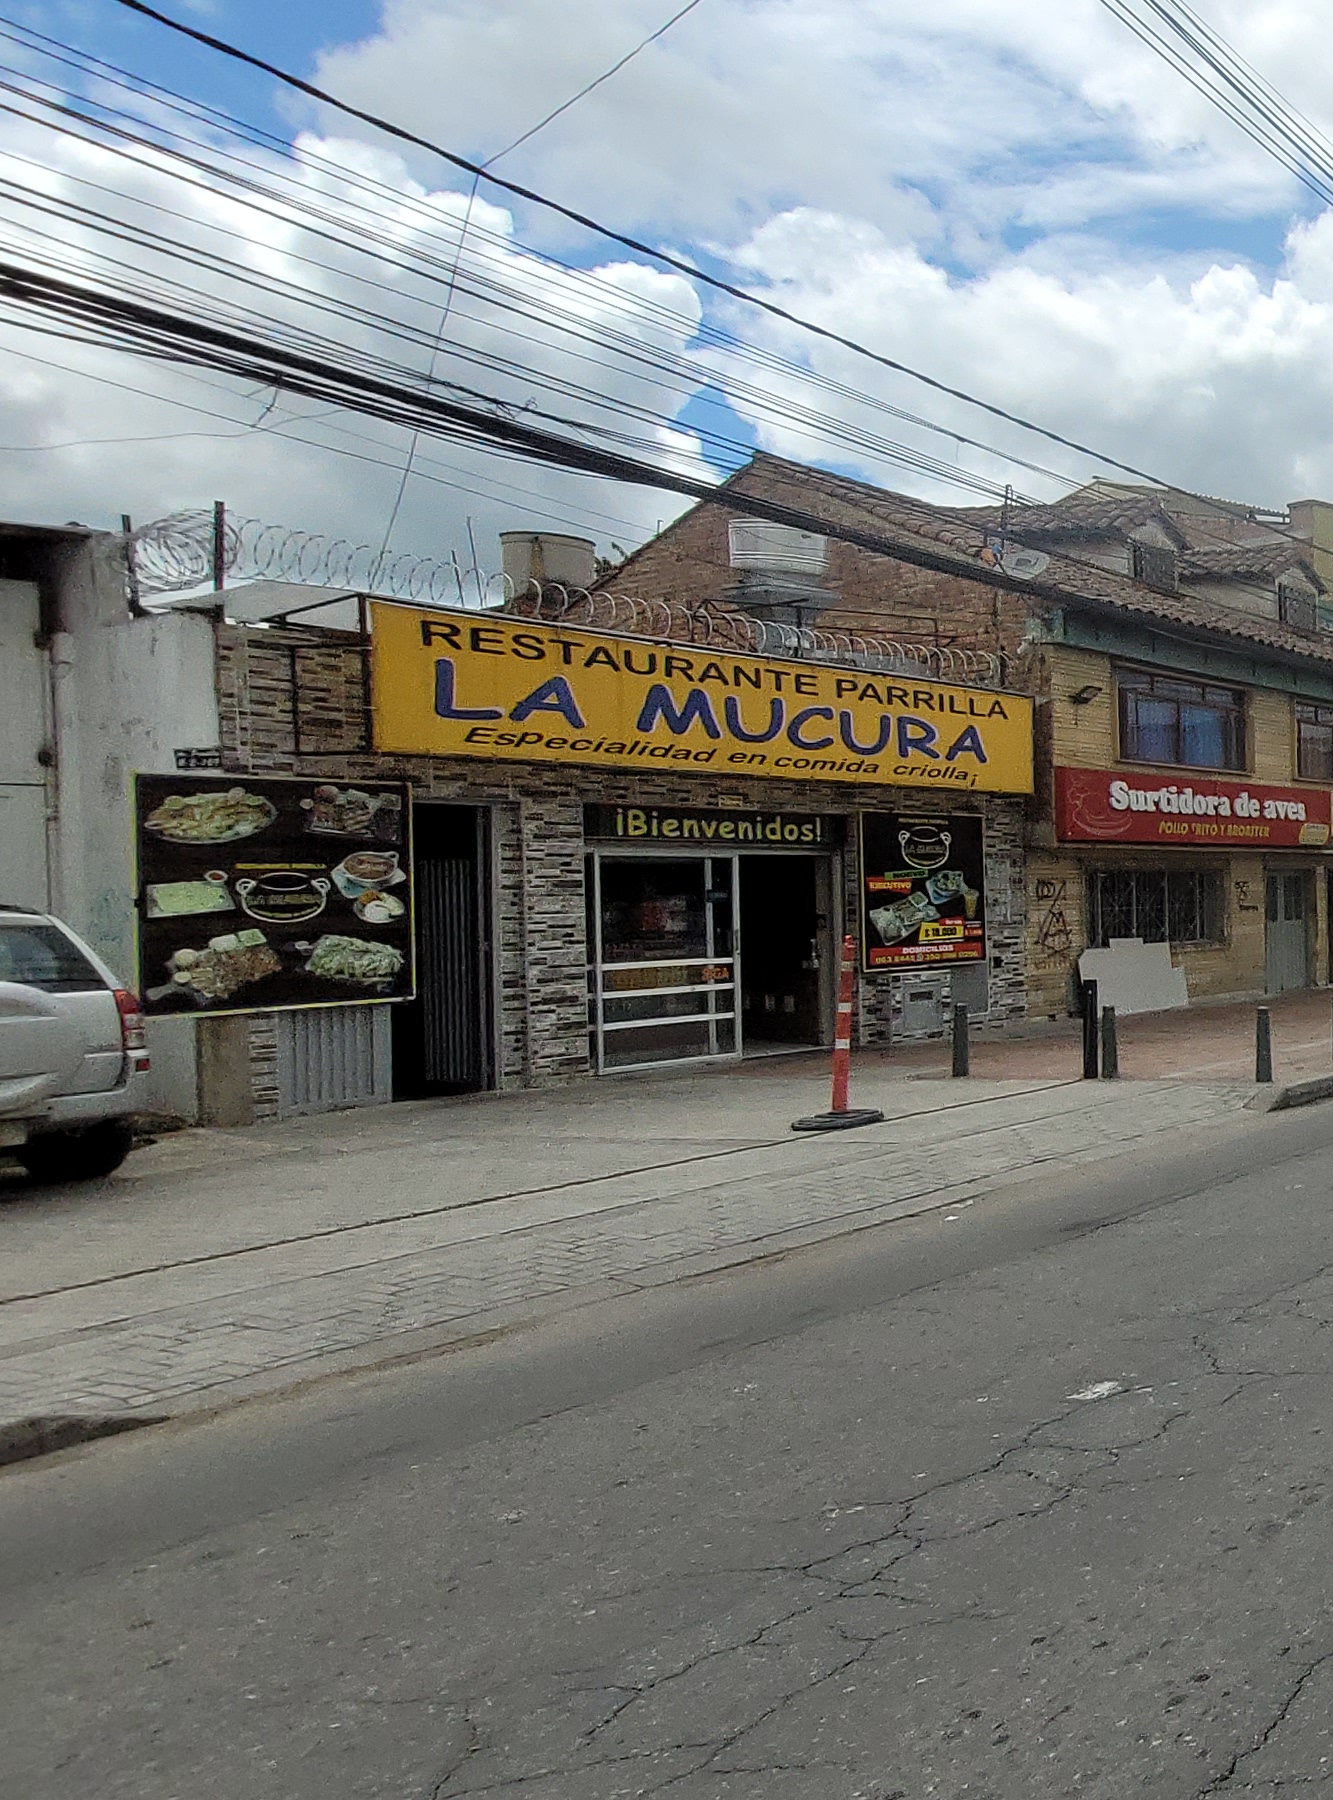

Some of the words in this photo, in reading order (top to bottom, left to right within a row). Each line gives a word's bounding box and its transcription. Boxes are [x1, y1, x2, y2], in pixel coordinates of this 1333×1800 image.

[420, 618, 819, 696] RESTAURANTE
[834, 677, 1009, 720] PARRILLA
[434, 657, 586, 729] LA
[635, 682, 988, 764] MUCURA
[463, 726, 731, 765] Especialidad
[731, 750, 769, 766] en
[773, 752, 880, 777] comida
[1109, 780, 1232, 818] Surtidora
[1233, 792, 1261, 818] de
[1263, 799, 1307, 822] aves
[616, 808, 822, 843] ¡Bienvenidos!
[1158, 820, 1189, 836] POLLO
[1220, 823, 1227, 837] Y
